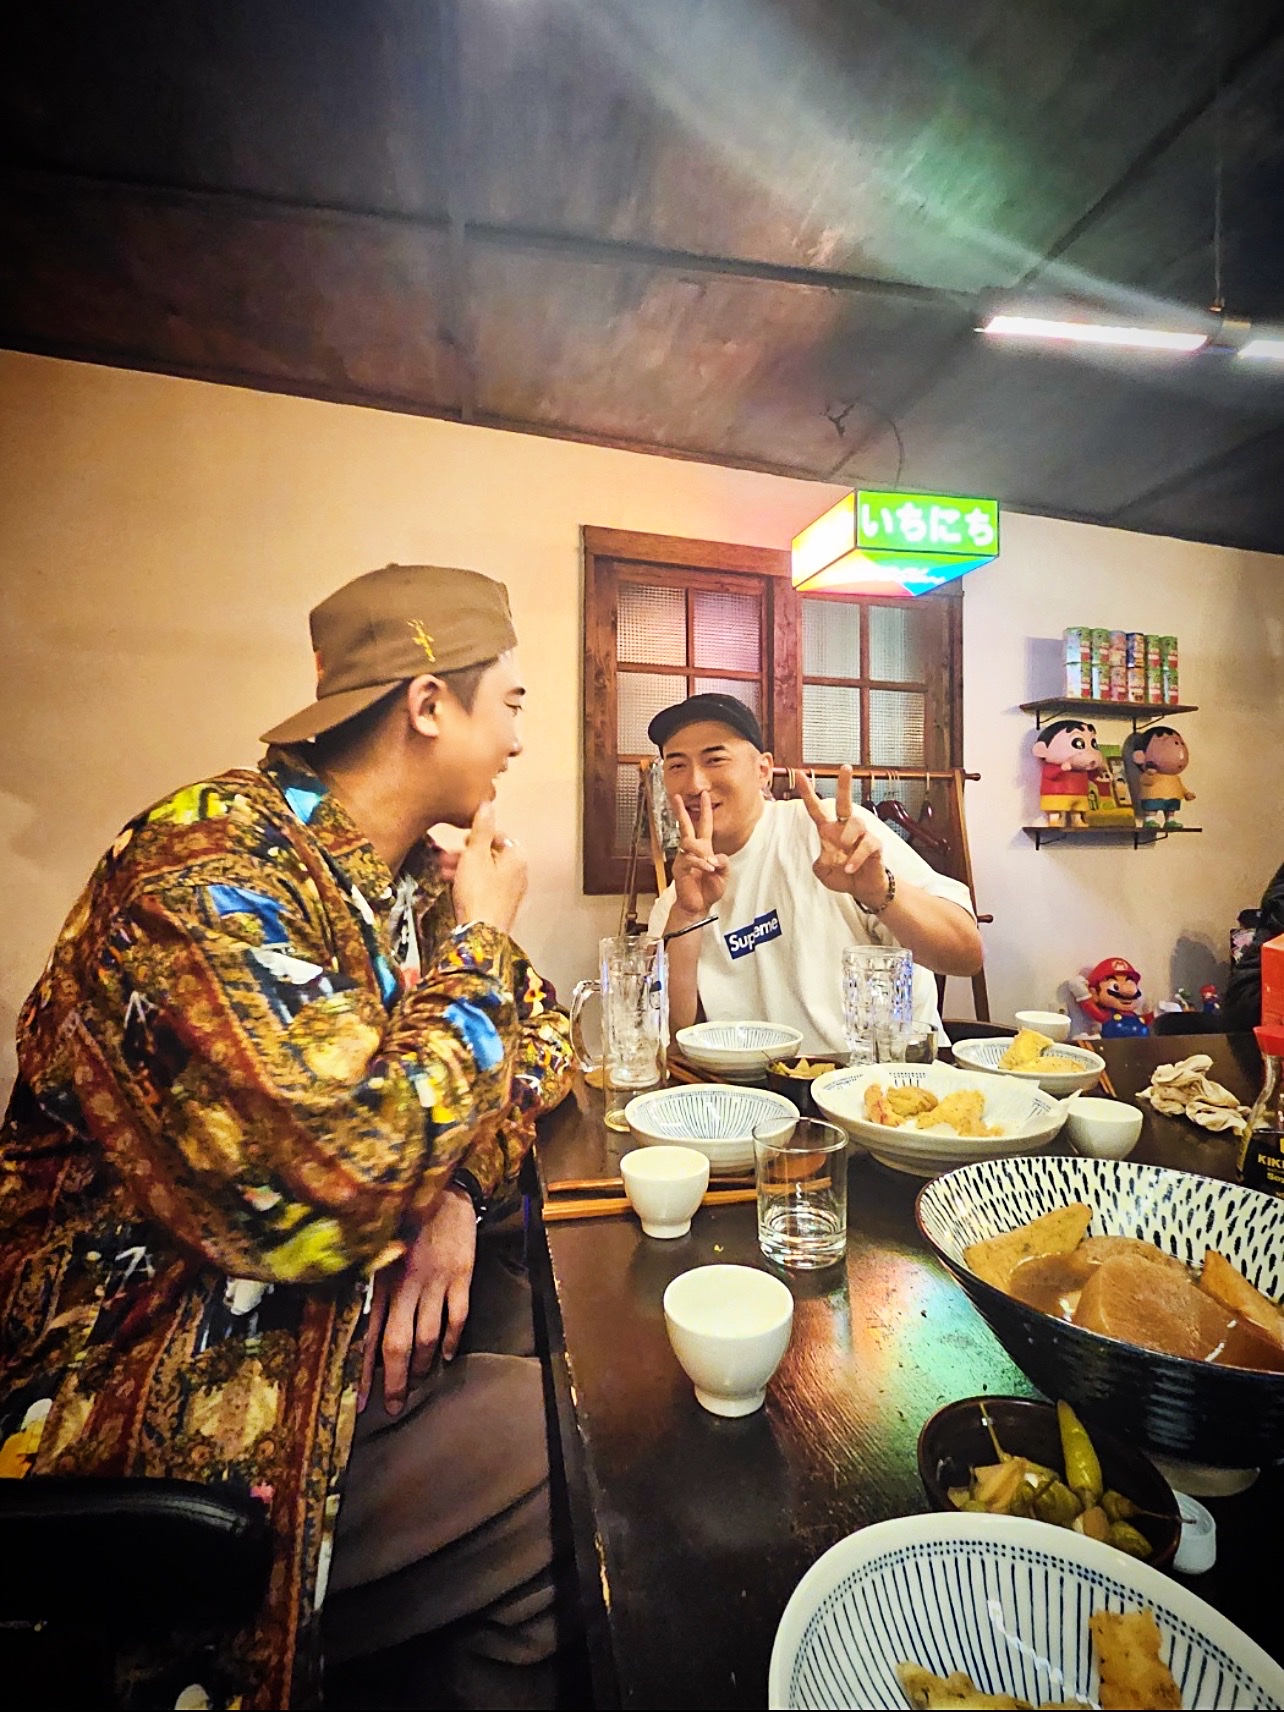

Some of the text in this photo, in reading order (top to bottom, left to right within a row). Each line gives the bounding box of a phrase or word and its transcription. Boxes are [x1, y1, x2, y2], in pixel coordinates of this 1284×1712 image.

[861, 502, 994, 547] いちにち
[728, 917, 779, 952] Supeme
[1112, 960, 1128, 970] M
[1258, 1153, 1284, 1169] KIK
